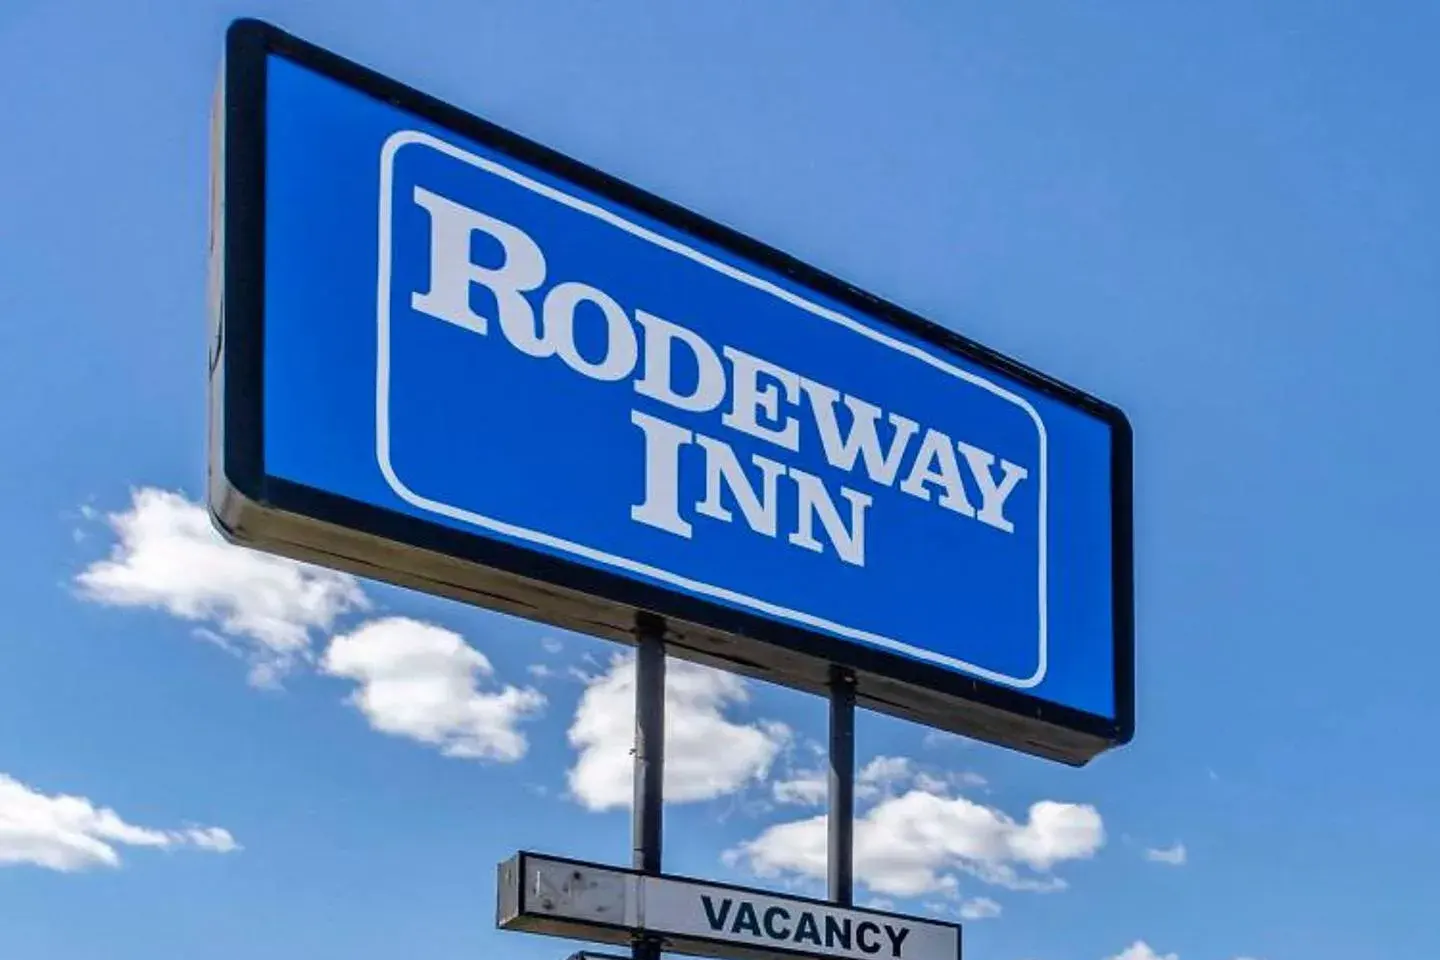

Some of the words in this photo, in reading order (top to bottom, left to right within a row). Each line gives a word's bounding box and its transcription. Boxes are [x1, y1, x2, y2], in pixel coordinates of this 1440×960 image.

[411, 185, 1028, 533] RODEWAY
[631, 410, 872, 567] INN
[701, 895, 911, 958] VACANCY
